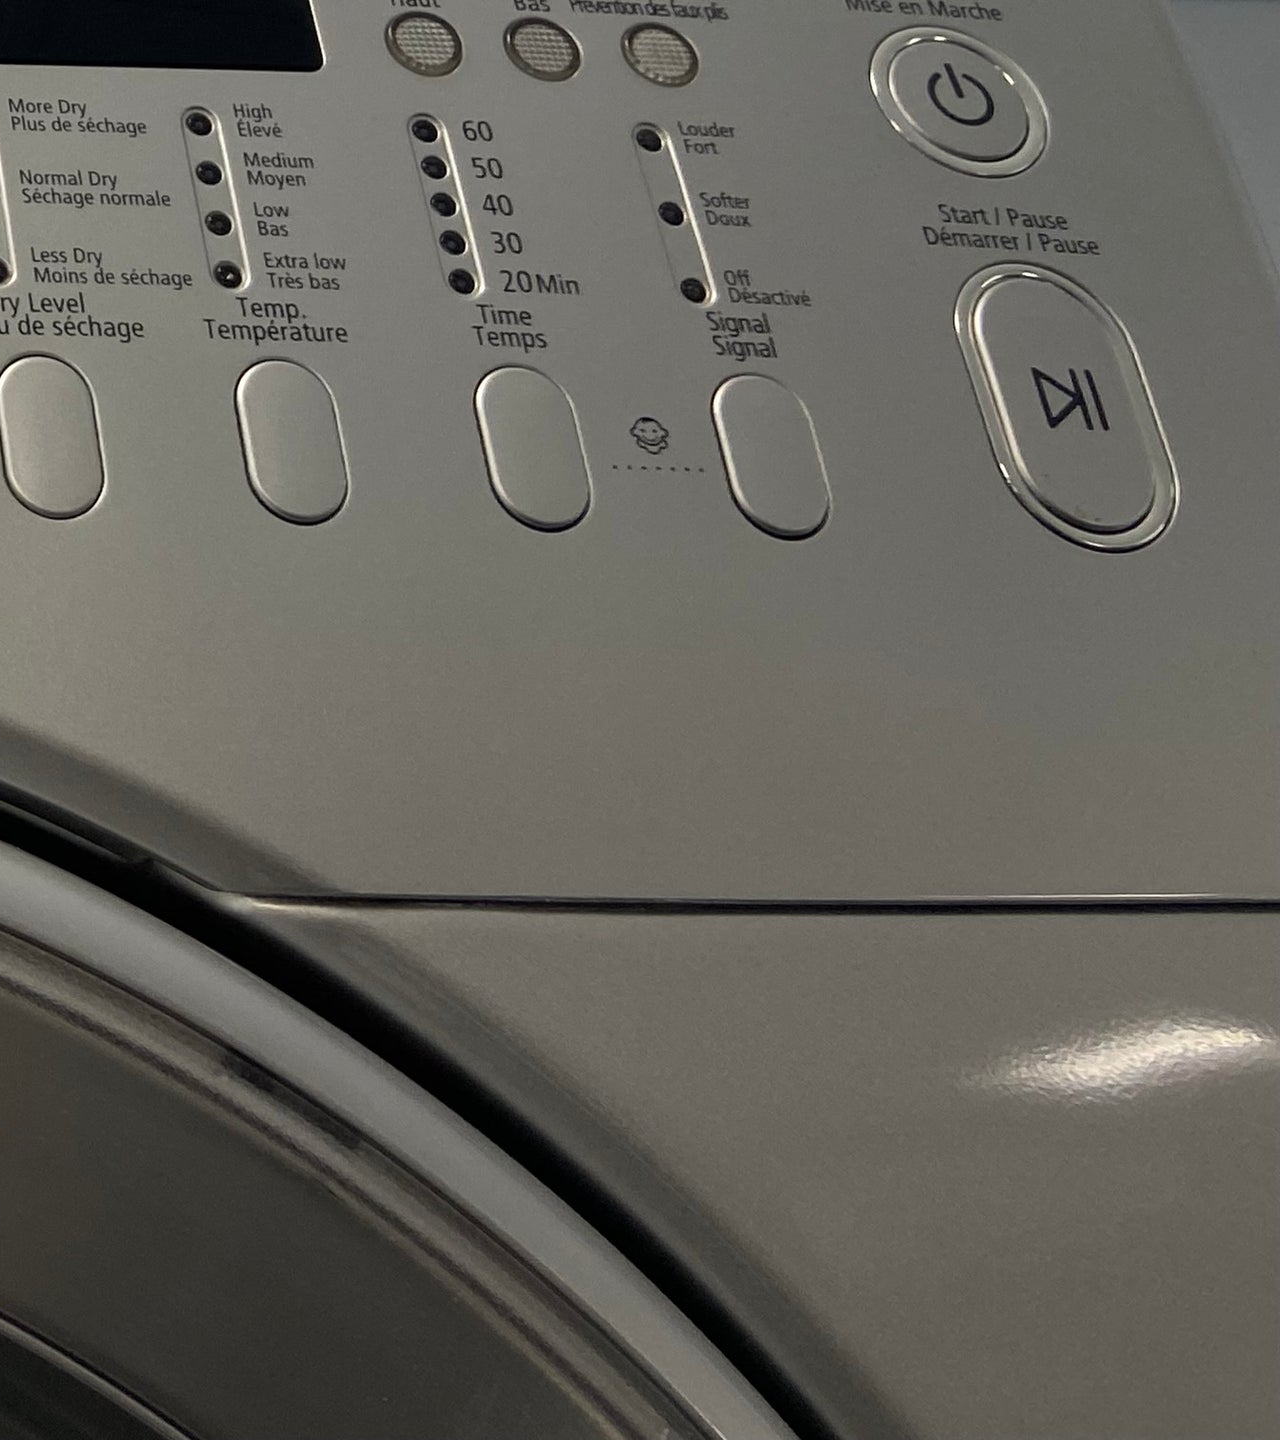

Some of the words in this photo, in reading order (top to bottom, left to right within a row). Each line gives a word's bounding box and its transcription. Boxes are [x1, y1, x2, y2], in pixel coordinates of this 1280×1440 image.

[898, 1, 922, 16] en
[9, 99, 52, 115] More
[59, 100, 87, 117] Dry
[234, 104, 273, 120] High
[11, 117, 46, 132] Plus
[51, 118, 73, 132] de
[77, 117, 147, 137] séchage
[238, 120, 283, 138] Élevé
[462, 121, 493, 142] 60
[678, 122, 735, 139] Louder
[684, 140, 718, 154] Fort
[244, 153, 314, 169] Medium
[472, 158, 503, 179] 50
[20, 170, 83, 186] Normal
[89, 171, 117, 190] Dry
[248, 171, 306, 190] Moyen
[22, 188, 95, 208] Séchage
[100, 192, 171, 207] normale
[482, 195, 513, 217] 40
[700, 193, 750, 209] Softer
[254, 202, 289, 218] Low
[705, 211, 751, 227] Doux
[939, 204, 990, 226] Start
[1007, 209, 1067, 231] Pause
[258, 221, 289, 237] Bas
[491, 232, 523, 254] 30
[922, 225, 1019, 251] Démarrer
[1041, 233, 1099, 256] Pause
[32, 248, 67, 263] Less
[74, 248, 102, 267] Dry
[264, 253, 308, 269] Extra
[313, 254, 346, 270] low
[34, 267, 88, 284] Moins
[94, 270, 116, 285] de
[122, 269, 193, 289] séchage
[267, 273, 304, 289] Très
[311, 274, 340, 291] bas
[724, 270, 750, 286] Off
[29, 293, 85, 313] Level
[728, 286, 812, 307] Désactivé
[236, 297, 307, 323] Temp.
[476, 304, 532, 326] Time
[18, 315, 45, 337] de
[54, 315, 144, 343] séchage
[203, 319, 348, 347] Température
[706, 312, 771, 336] Signal
[472, 326, 548, 353] Temps
[712, 336, 778, 362] Signal
